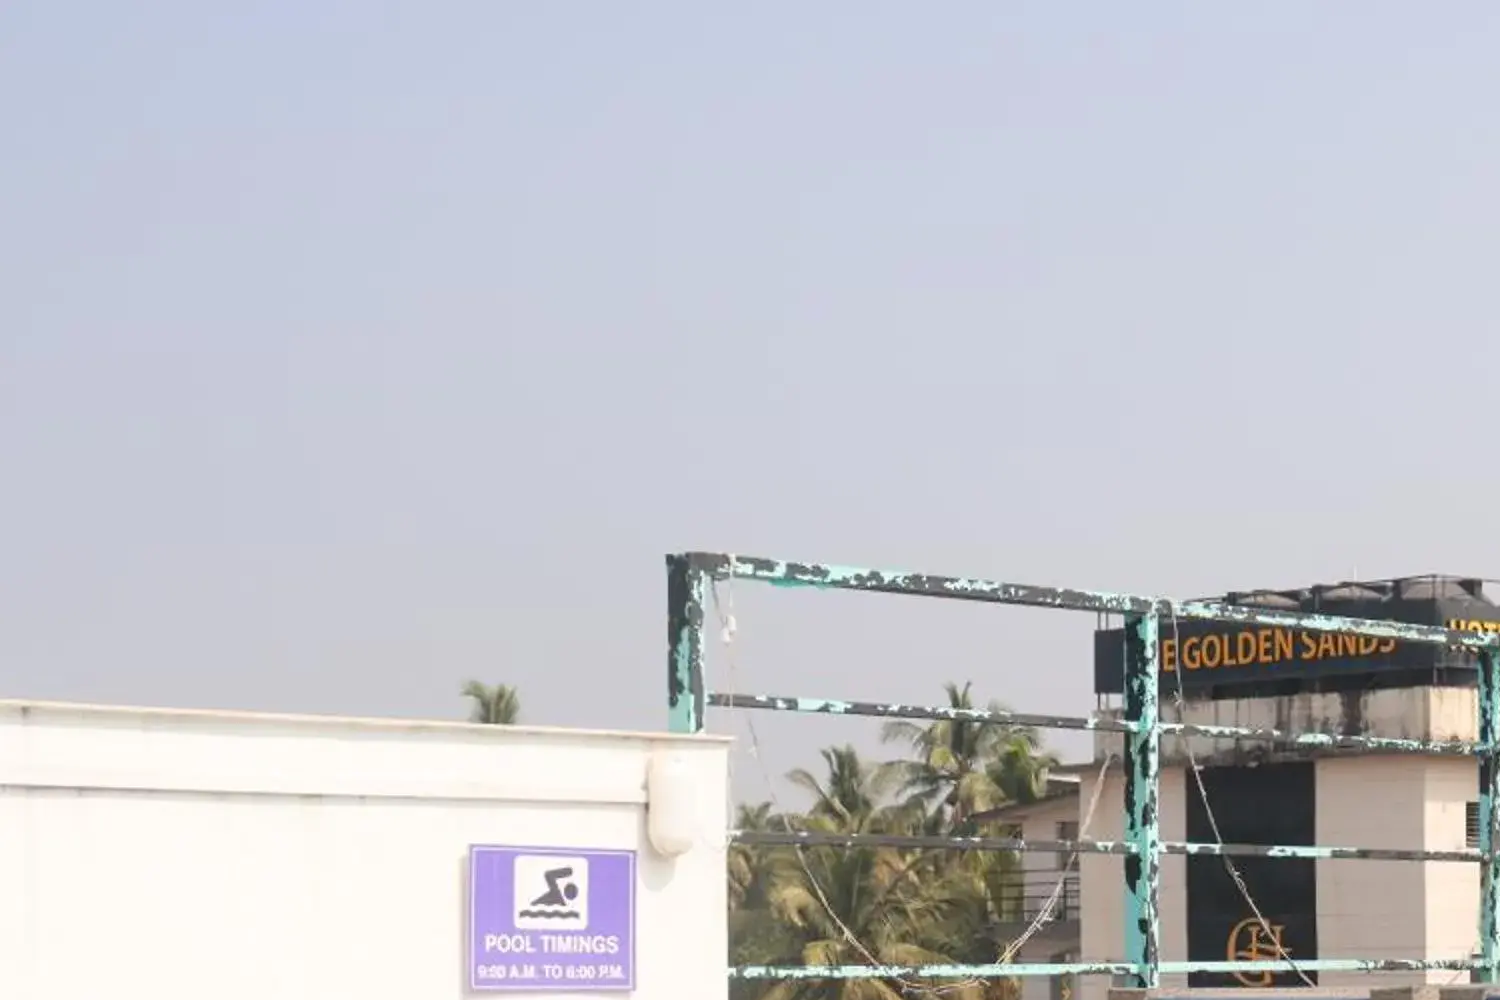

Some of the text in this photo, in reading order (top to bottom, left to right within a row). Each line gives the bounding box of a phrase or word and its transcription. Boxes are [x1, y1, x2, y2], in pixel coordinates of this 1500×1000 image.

[1182, 628, 1293, 670] GOLDEN
[485, 934, 620, 954] POOL TIMINGS
[543, 964, 564, 980] TO
